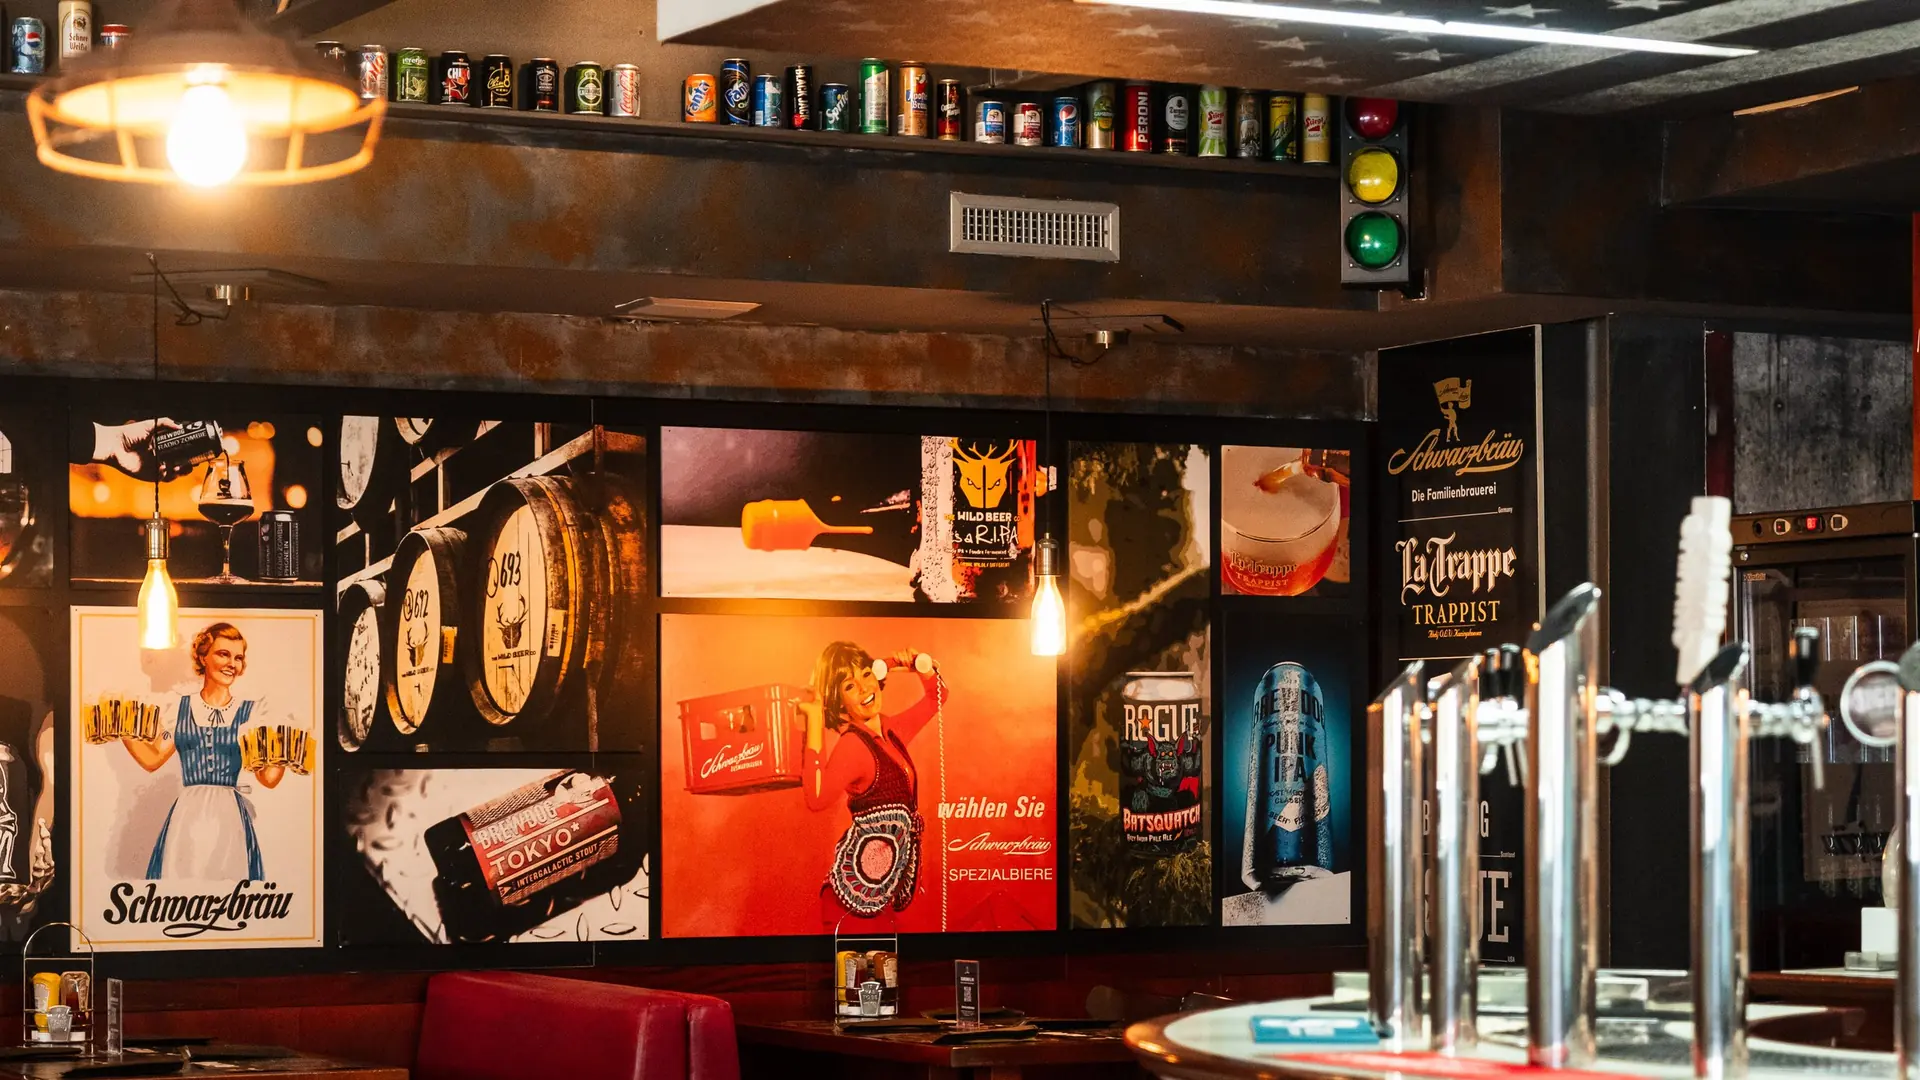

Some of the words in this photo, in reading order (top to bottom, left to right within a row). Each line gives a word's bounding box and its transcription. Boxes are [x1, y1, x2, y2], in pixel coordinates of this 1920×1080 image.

[795, 67, 808, 97] BLACK
[685, 80, 710, 117] Fanta
[797, 98, 810, 120] JACK
[1137, 91, 1149, 143] PERONI
[157, 440, 180, 451] RADIO
[180, 431, 207, 445] ZOMBIE
[1387, 428, 1524, 477] Schwarzbräu
[1411, 488, 1425, 502] Die
[1426, 481, 1497, 501] Familienbrauerei
[957, 511, 985, 522] WILD
[985, 511, 1012, 522] BEER
[500, 551, 522, 588] 693
[1235, 571, 1289, 587] TRAPPIST
[414, 589, 429, 618] 692
[1411, 600, 1501, 625] TRAPPIST
[498, 652, 512, 660] WILD
[512, 649, 530, 657] BEER
[1123, 703, 1200, 742] ROGUE
[1265, 731, 1317, 761] PUNK
[1273, 755, 1308, 783] IPA
[937, 796, 1008, 819] wählen
[1014, 795, 1045, 818] Sie
[1122, 803, 1201, 833] BATSQUATCH
[473, 799, 558, 850] BREWDOG
[1148, 833, 1162, 843] PALE
[1162, 831, 1173, 841] ALE
[947, 831, 1052, 856] Schwarzbräu
[515, 854, 574, 889] INTERGALACTIC
[575, 843, 599, 861] STOUT
[948, 867, 1053, 882] SPEZIALBIERE
[103, 879, 294, 938] Schwarzbräu
